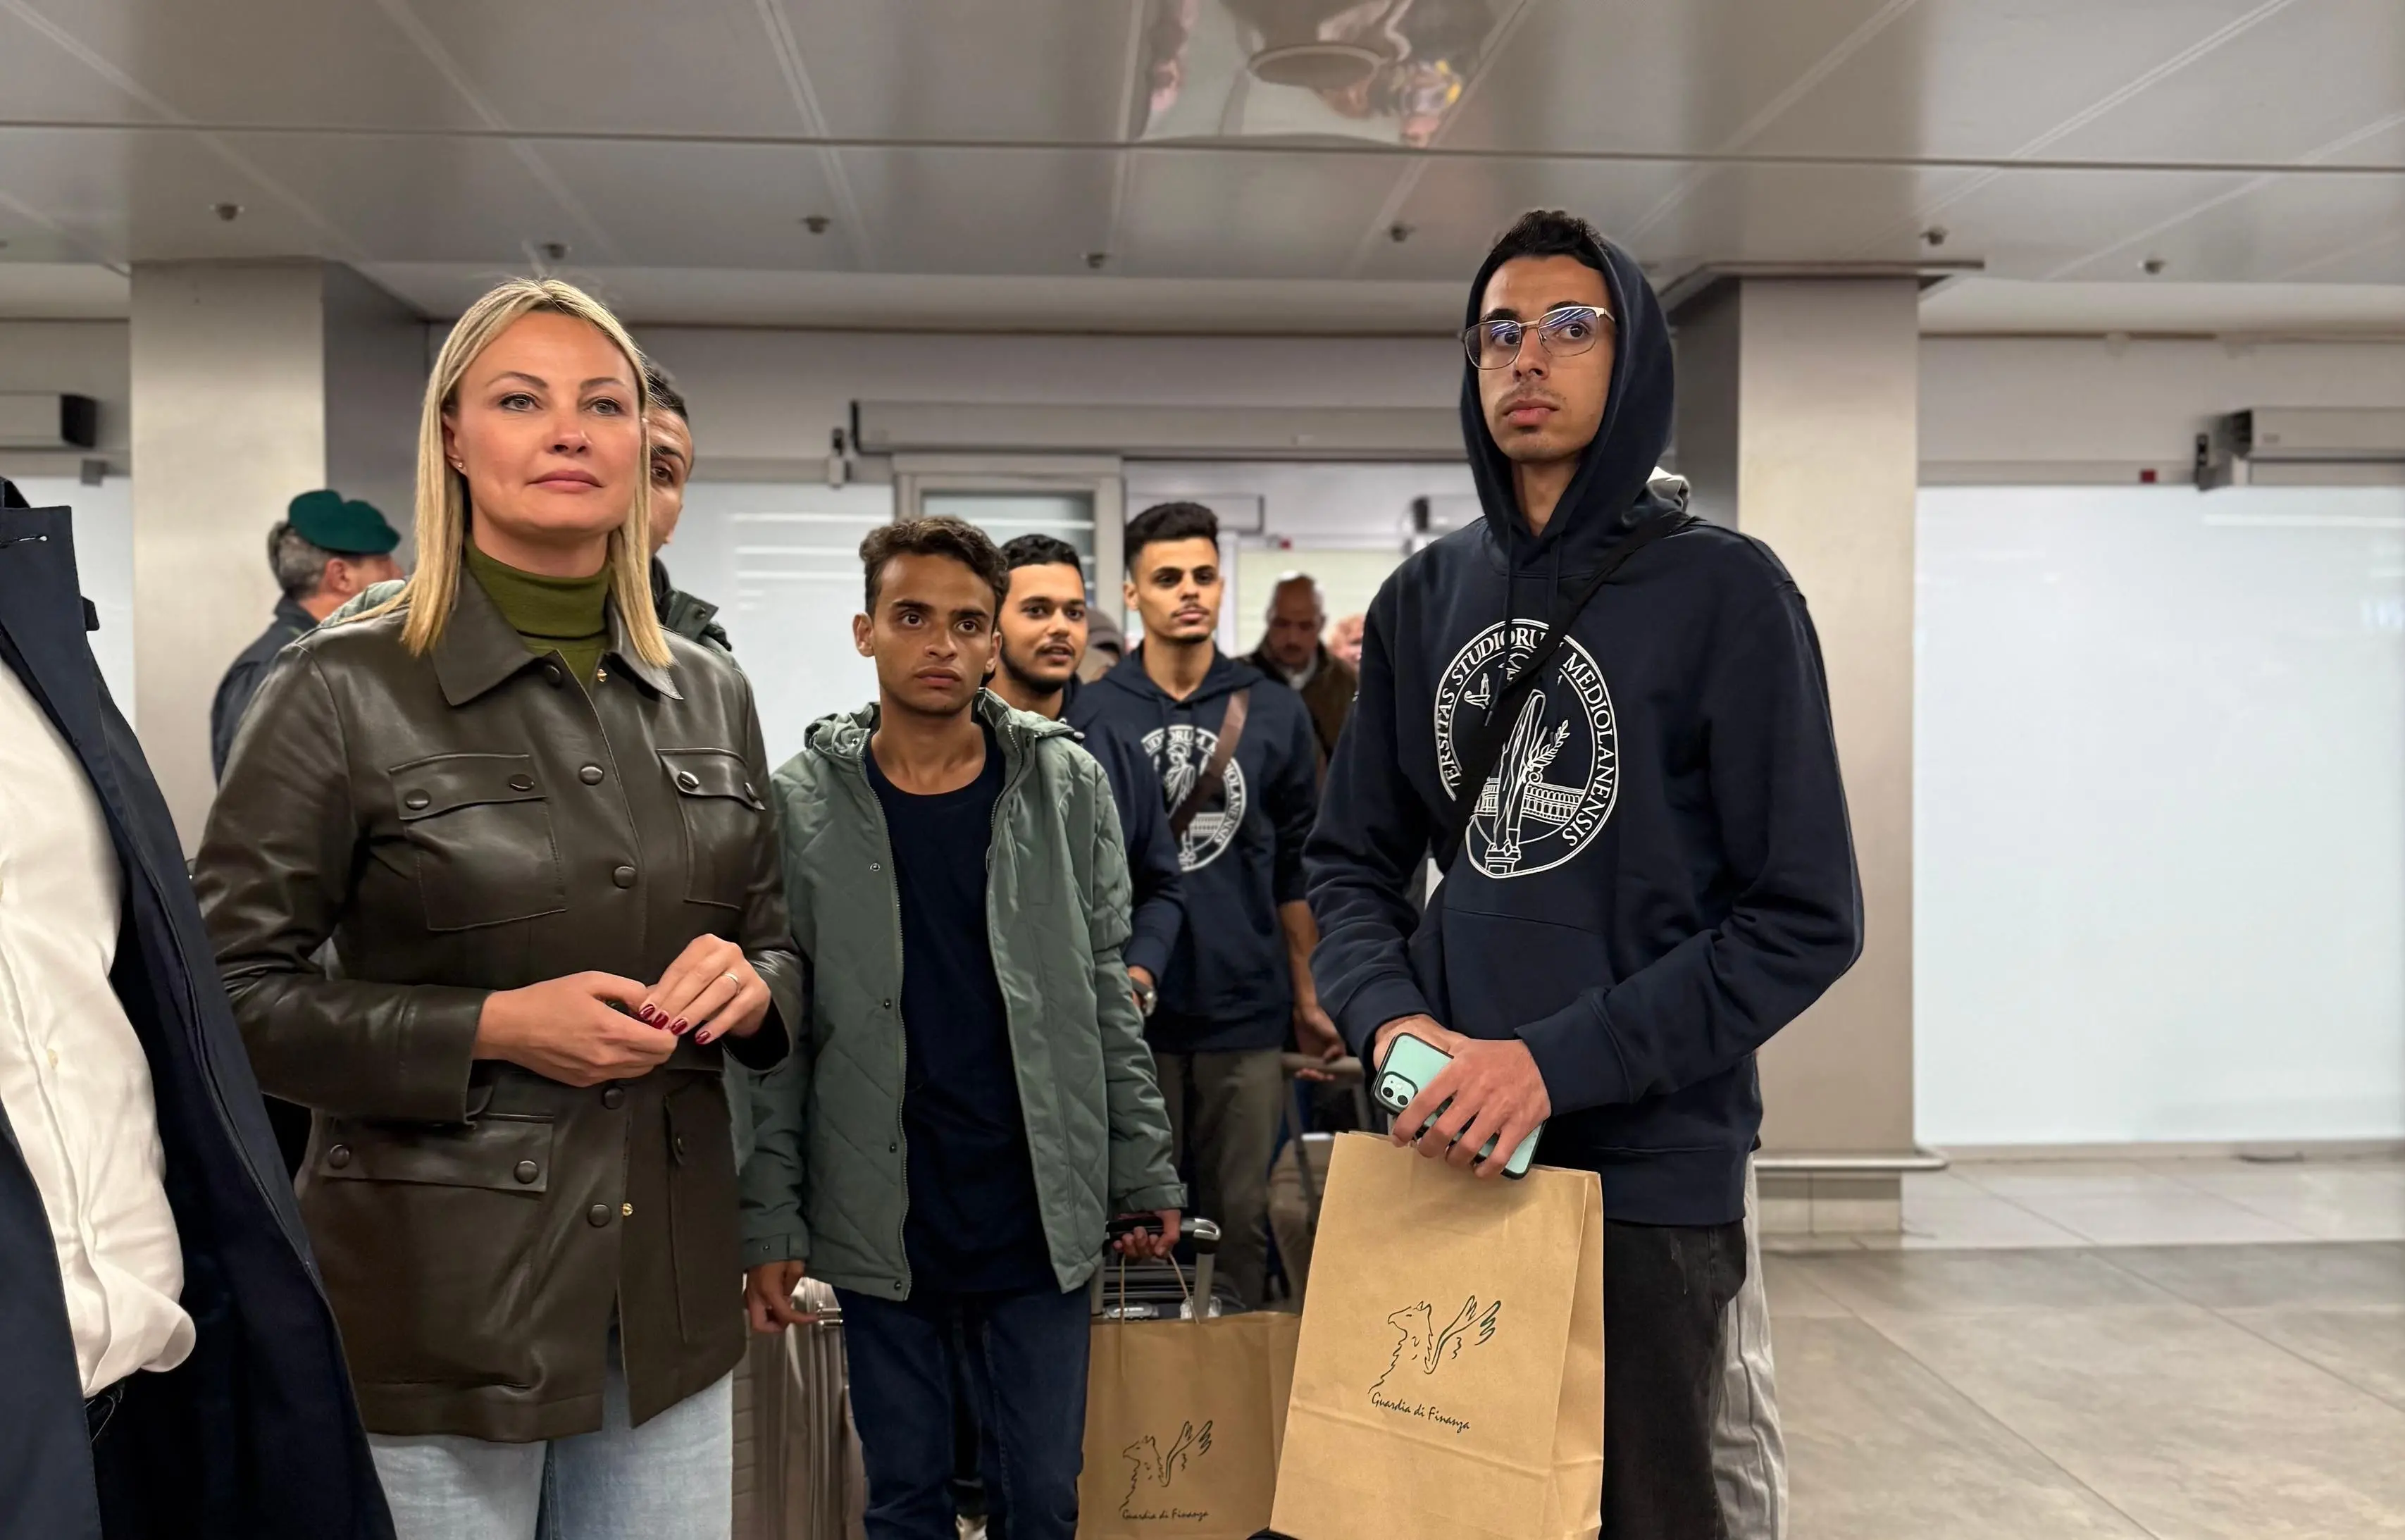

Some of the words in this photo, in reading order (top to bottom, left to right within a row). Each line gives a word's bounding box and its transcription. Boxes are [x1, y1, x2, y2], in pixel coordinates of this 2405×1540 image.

[1451, 626, 1548, 687] STUDIORU
[1561, 652, 1614, 847] MEDIOLANENSIS
[1372, 1391, 1411, 1413] Guardia
[1413, 1403, 1425, 1417] di
[1428, 1406, 1470, 1434] Finanza
